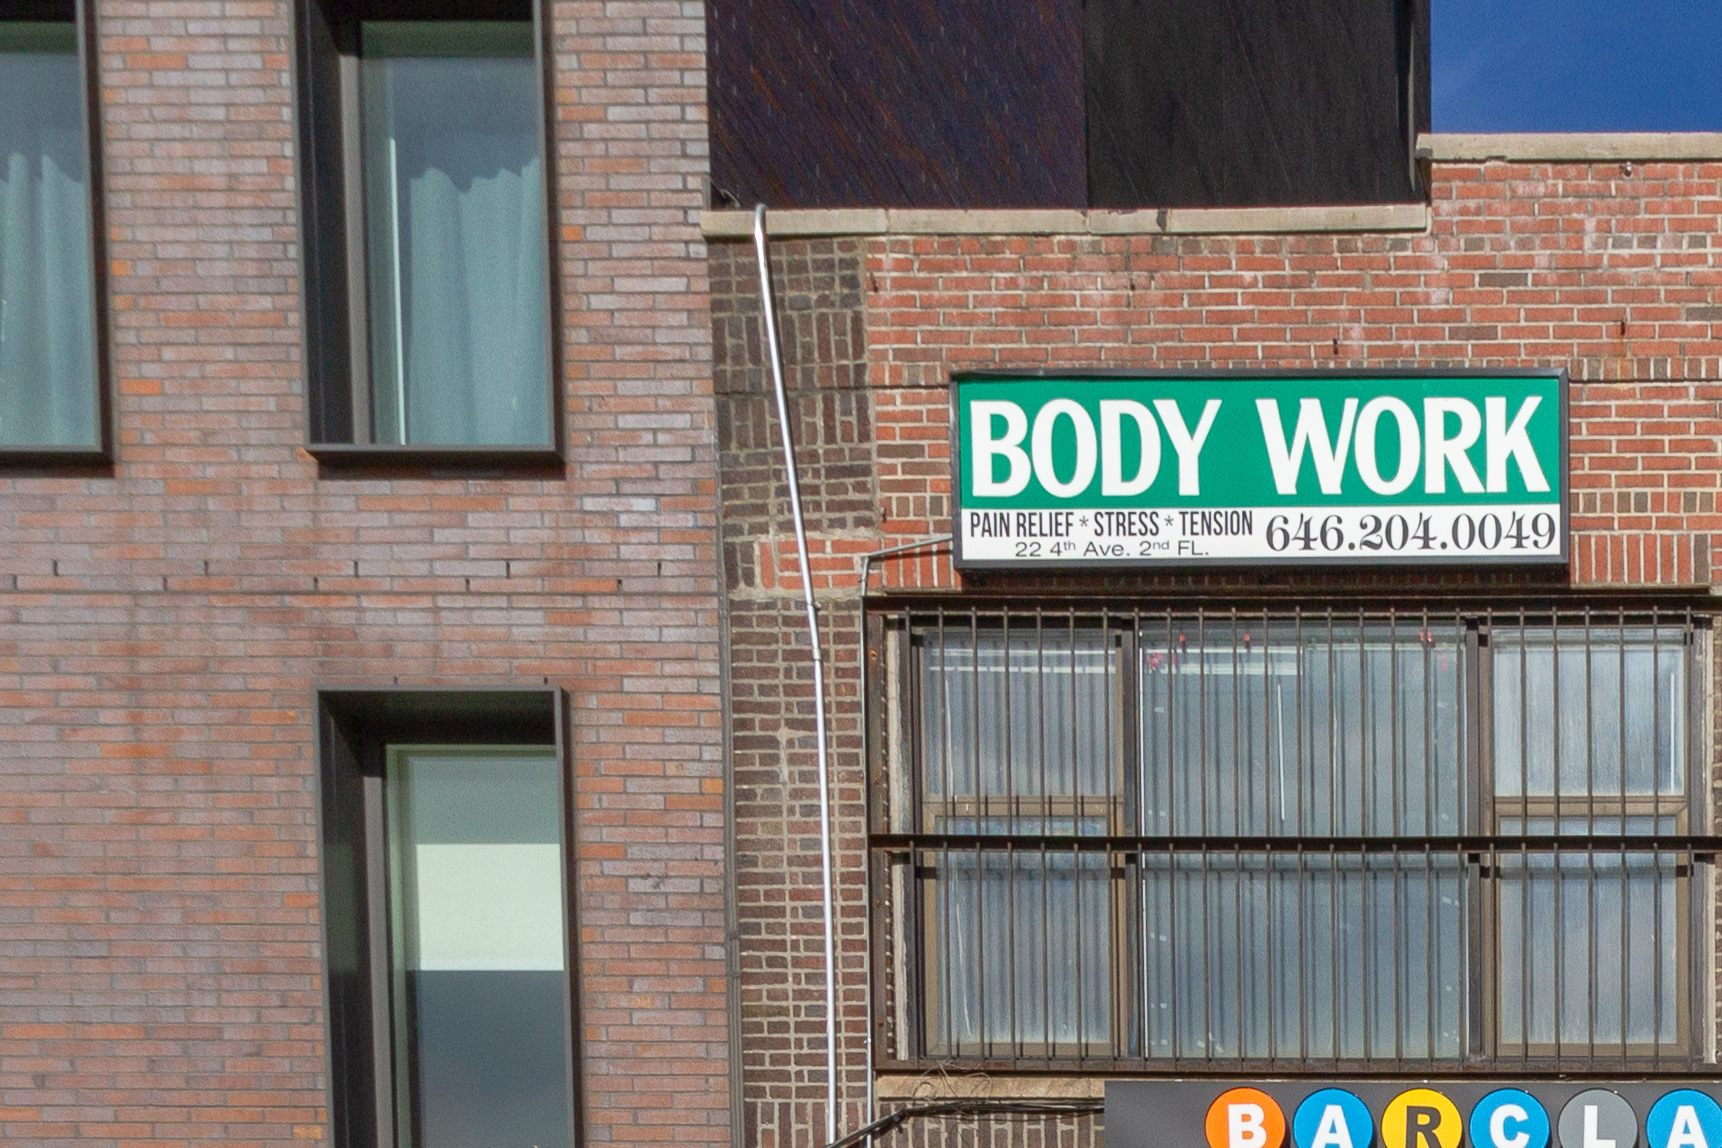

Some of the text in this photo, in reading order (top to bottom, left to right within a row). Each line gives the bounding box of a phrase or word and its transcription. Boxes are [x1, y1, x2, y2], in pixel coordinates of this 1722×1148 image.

[970, 395, 1551, 498] BODY WORK
[970, 510, 1253, 538] PAIN RELIEF STRESS TENSION
[1265, 512, 1557, 553] 646.204.0049
[1015, 540, 1209, 557] 22 4th Ave. 2nd FL.
